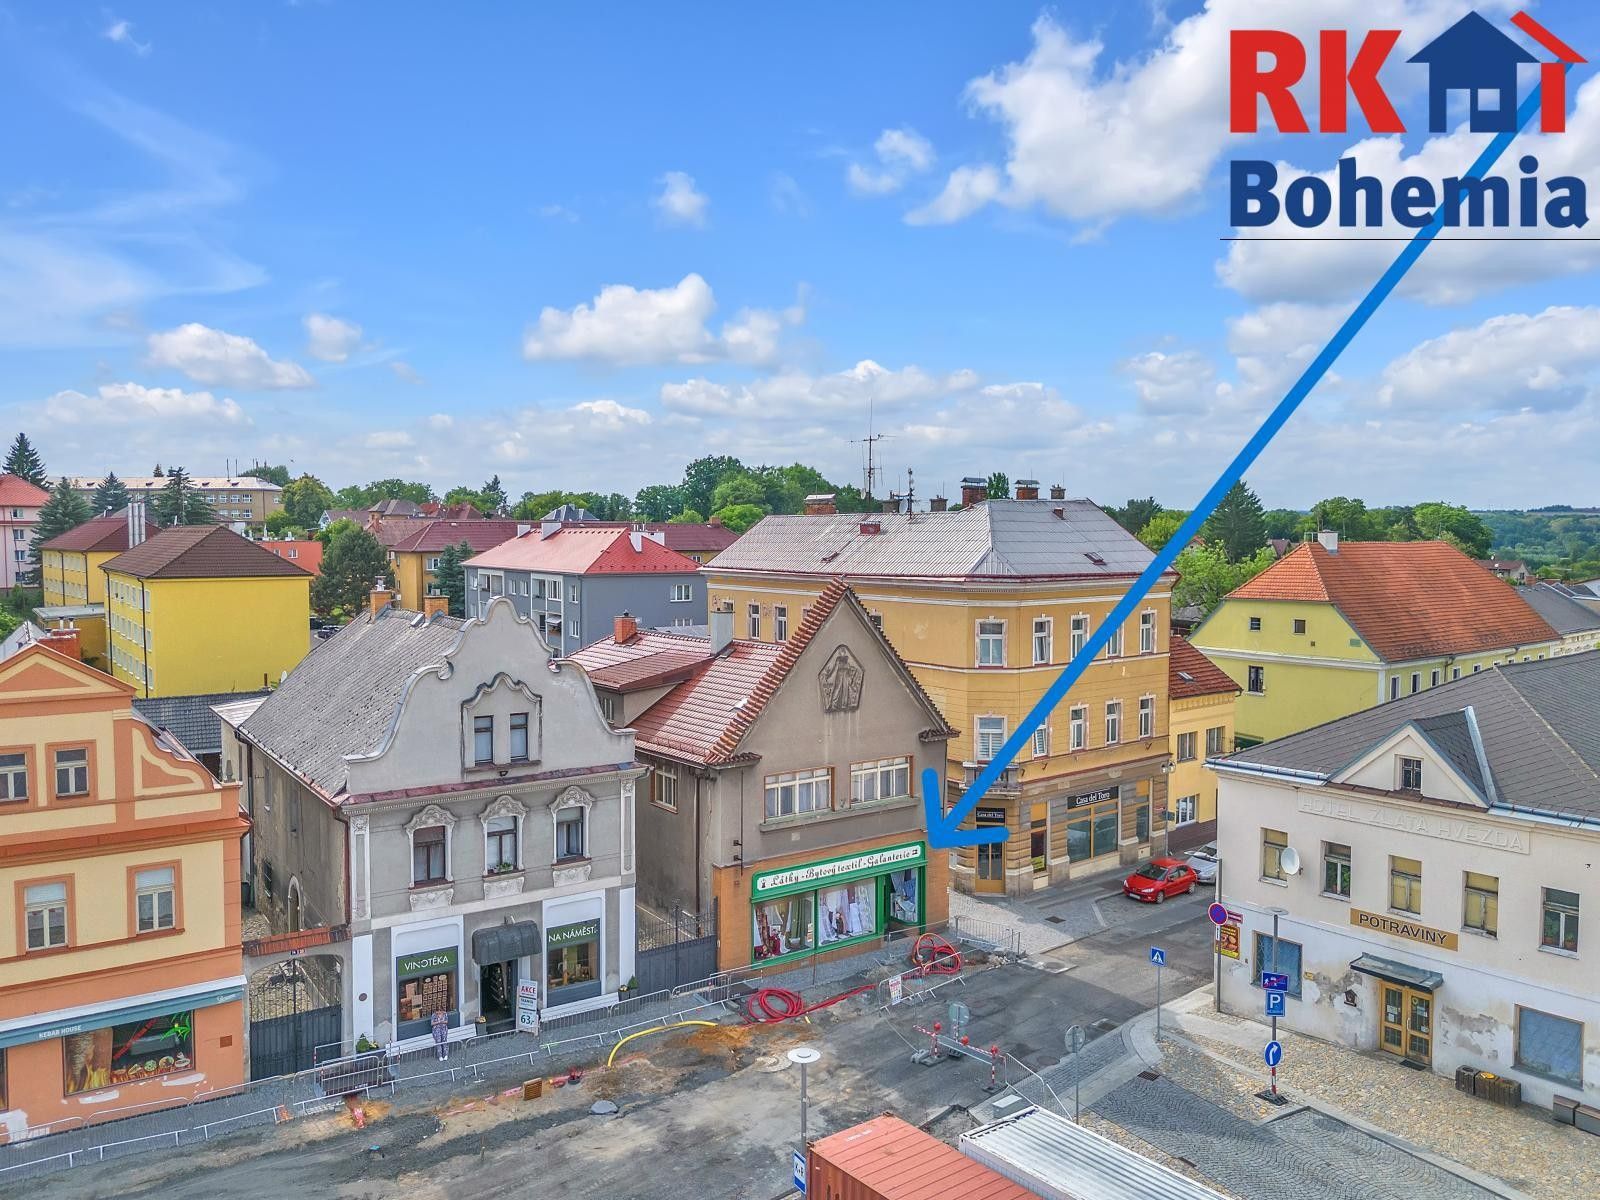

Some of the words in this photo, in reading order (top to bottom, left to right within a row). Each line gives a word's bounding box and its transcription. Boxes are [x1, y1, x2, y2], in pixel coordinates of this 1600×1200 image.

[1076, 796, 1088, 804] Casa
[1089, 792, 1097, 802] del
[1098, 791, 1110, 800] Toro
[770, 873, 799, 887] Látky
[837, 860, 862, 873] textil
[867, 851, 910, 868] Galanterie
[1359, 913, 1447, 944] POTRAVINY
[548, 933, 562, 942] NA
[404, 955, 449, 971] VINOTÉKA
[521, 985, 536, 994] AKCE
[1269, 994, 1281, 1009] P
[39, 1029, 60, 1039] KEBAB
[61, 1024, 82, 1035] HOUSE
